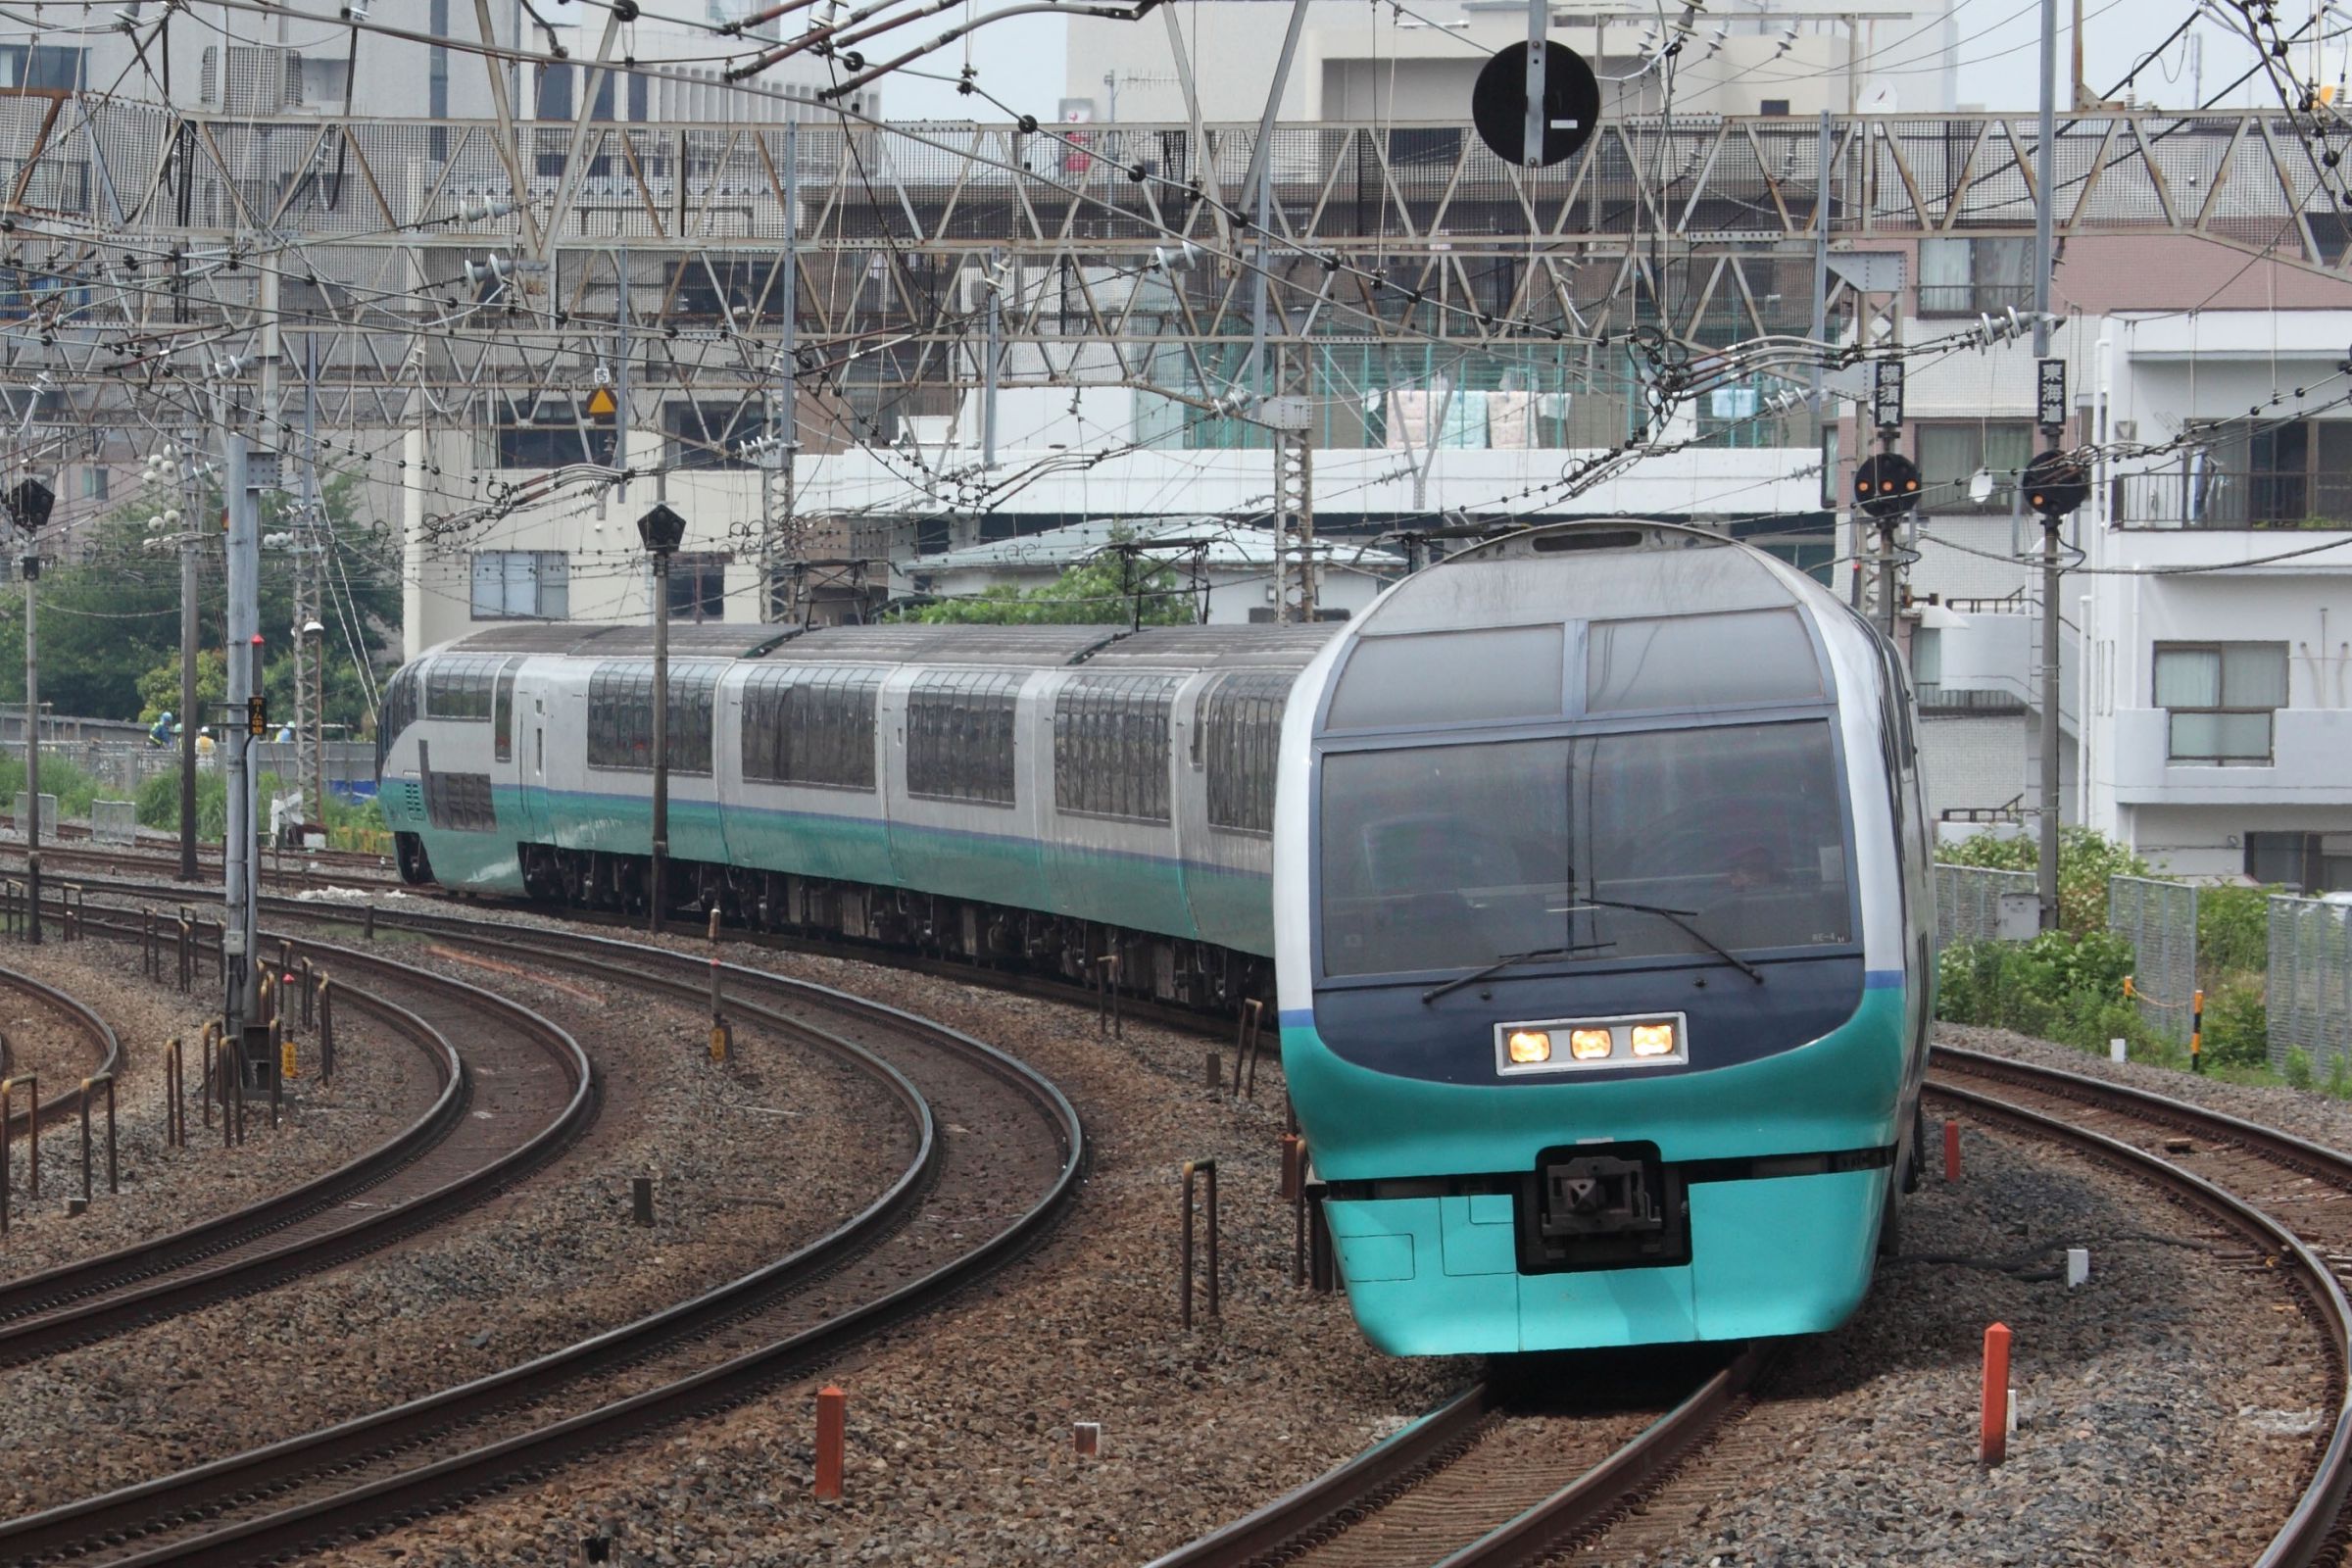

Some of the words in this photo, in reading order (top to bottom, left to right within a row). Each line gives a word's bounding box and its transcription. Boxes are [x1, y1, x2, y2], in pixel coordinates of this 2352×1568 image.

[1879, 365, 1900, 424] 横須賀
[2041, 363, 2062, 422] 東海道
